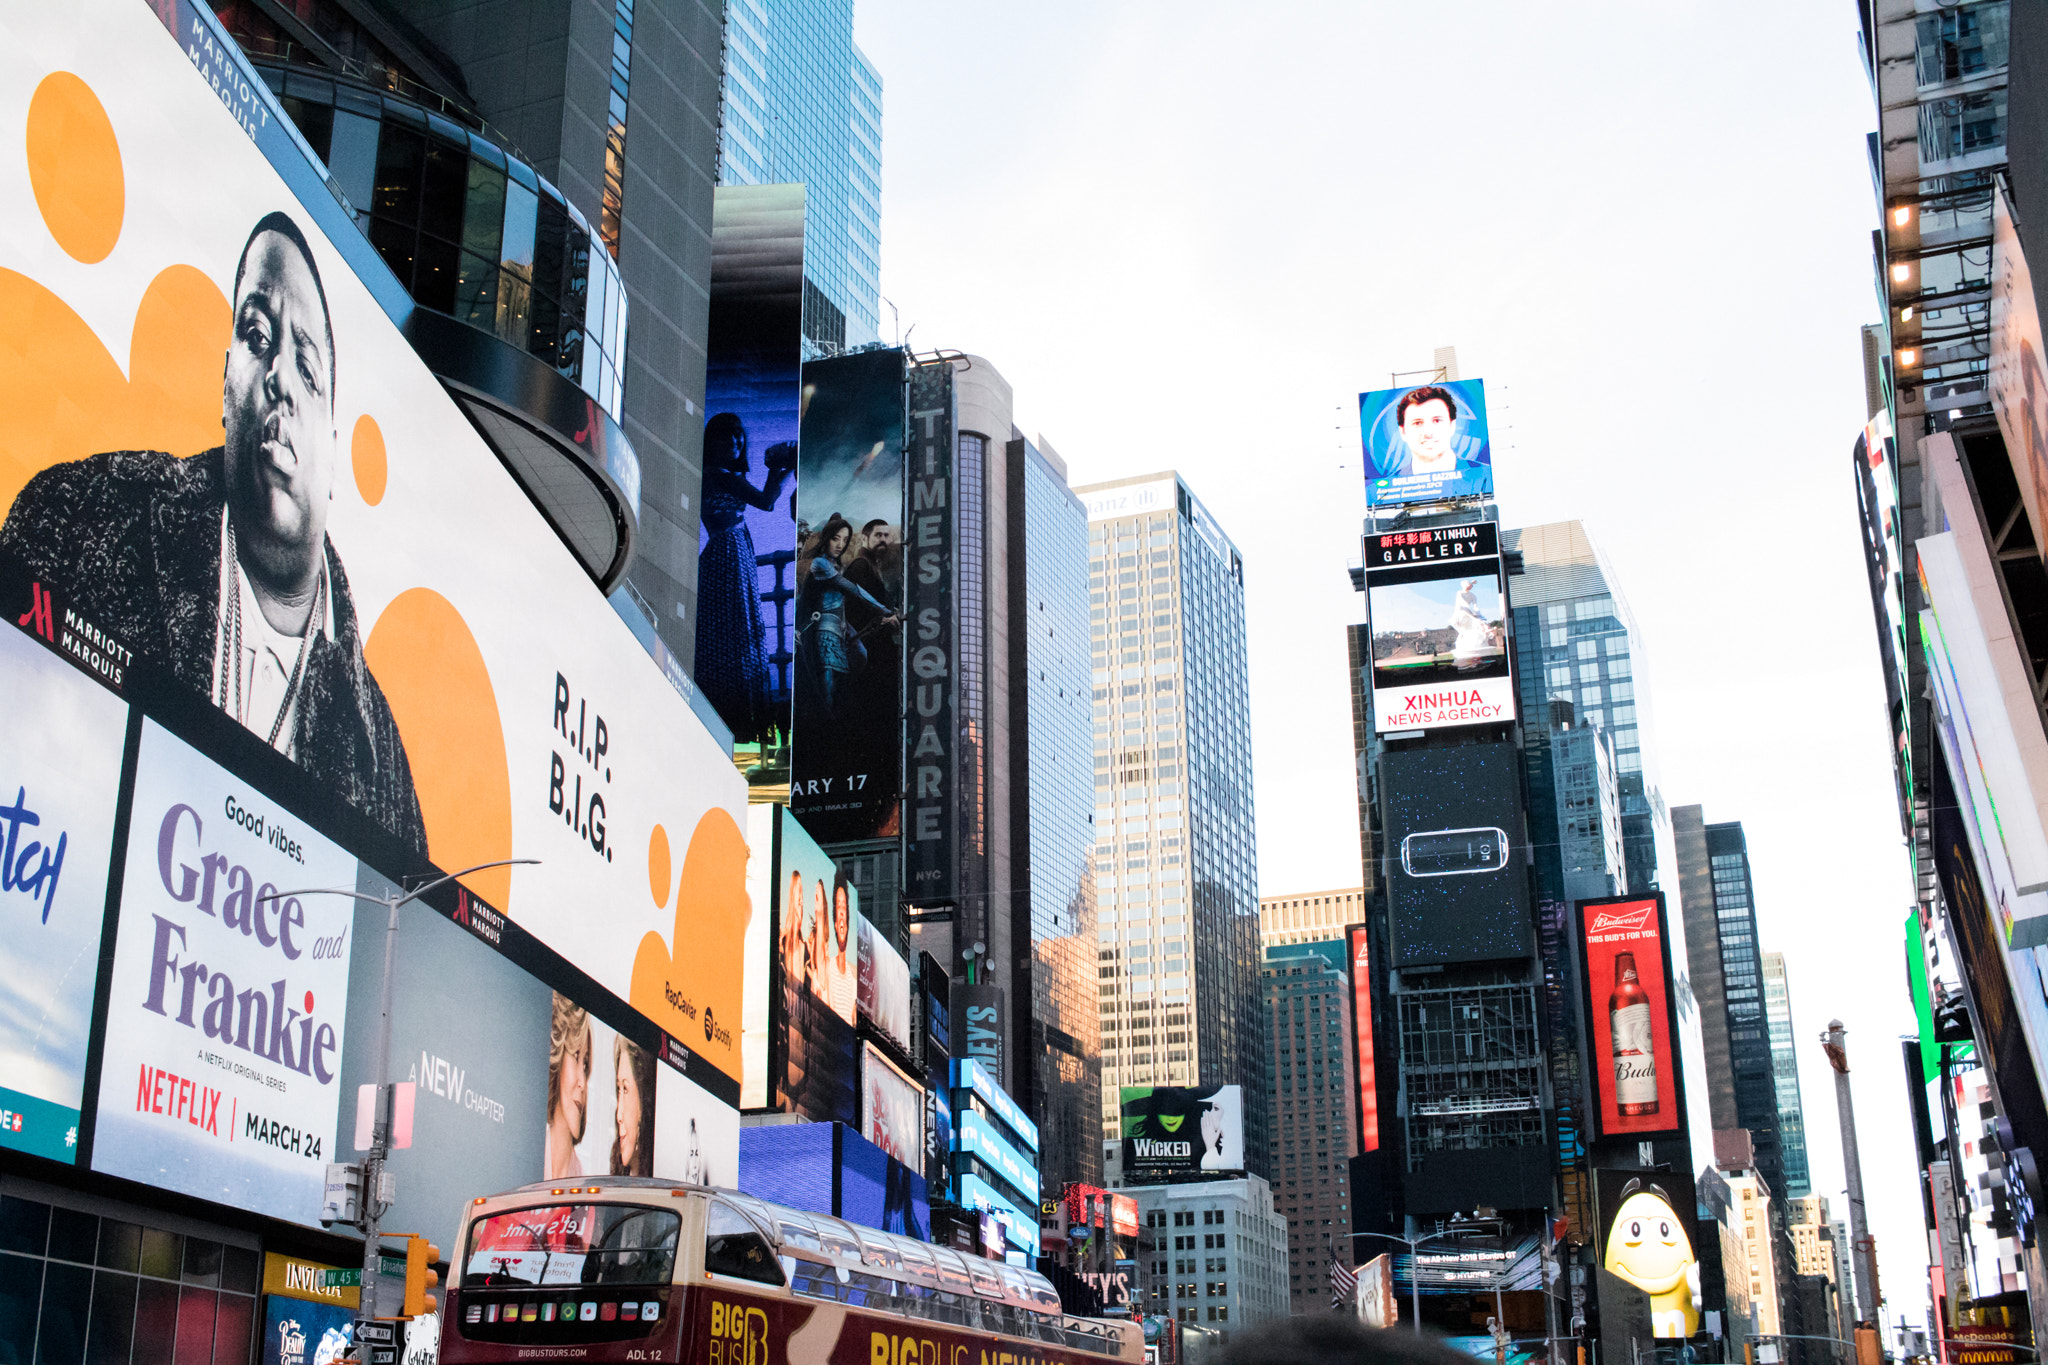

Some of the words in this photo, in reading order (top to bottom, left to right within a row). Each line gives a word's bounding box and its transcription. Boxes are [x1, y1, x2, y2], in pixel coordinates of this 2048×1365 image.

[192, 18, 268, 127] MARRIOTT
[189, 44, 256, 141] MARQUIS
[913, 407, 945, 584] TIMES
[1380, 531, 1432, 548] 新华影廊
[1433, 527, 1478, 542] XINHUA
[1383, 541, 1478, 563] GALLERY
[65, 609, 133, 667] MARRIOTT
[62, 631, 122, 685] MARQUIS
[1404, 689, 1483, 711] XINHUA
[553, 669, 612, 784] R.I.P.
[913, 608, 948, 842] SQUARE
[1388, 712, 1433, 727] NEWS
[1437, 704, 1502, 723] AGENCY
[847, 774, 867, 791] 17
[549, 749, 613, 864] B.I.G.
[825, 803, 847, 811] IMAX
[225, 795, 264, 838] Good
[267, 823, 305, 865] vibes.
[157, 803, 304, 961] Grace
[312, 924, 347, 960] and
[916, 870, 942, 882] NYC
[472, 900, 505, 930] MARRIOTT
[1594, 915, 1645, 928] Budweiser
[472, 916, 500, 944] MARQUIS
[1587, 934, 1604, 943] THIS
[1604, 933, 1626, 942] BUD'S
[1626, 931, 1641, 939] FOR
[1641, 930, 1658, 938] YOU.
[142, 912, 336, 1085] Frankie
[665, 980, 697, 1021] RapCaviar
[670, 1040, 688, 1059] MARRIOTT
[714, 1021, 732, 1051] Spotify
[198, 1050, 203, 1060] A
[204, 1052, 232, 1071] NETFLIX
[234, 1064, 264, 1084] ORIGINAL
[265, 1076, 286, 1092] SERIES
[669, 1052, 686, 1070] MARQUIS
[136, 1063, 221, 1137] NETFLIX
[408, 1063, 416, 1083] A
[420, 1050, 465, 1104] NEW
[464, 1088, 504, 1124] CHAPTER
[246, 1112, 300, 1153] MARCH
[304, 1133, 321, 1160] 24
[927, 1089, 936, 1158] NEW
[382, 1260, 406, 1273] Broadwa
[1431, 1254, 1460, 1263] All-New
[1460, 1253, 1478, 1261] 2018
[1479, 1251, 1504, 1260] Elantra
[286, 1262, 341, 1298] INVI
[327, 1272, 336, 1285] W
[340, 1272, 350, 1285] 45
[355, 1271, 361, 1280] St
[1075, 1272, 1129, 1304] EY'S
[360, 1327, 371, 1337] ONE
[376, 1328, 389, 1338] WAY
[711, 1301, 743, 1340] BIG
[1953, 1332, 2014, 1341] McDonald's
[373, 1353, 390, 1362] WAY
[518, 1349, 586, 1357] BIGBUSTOURS.COM
[627, 1350, 646, 1360] ADL
[650, 1350, 662, 1360] 12
[709, 1339, 742, 1365] BUS
